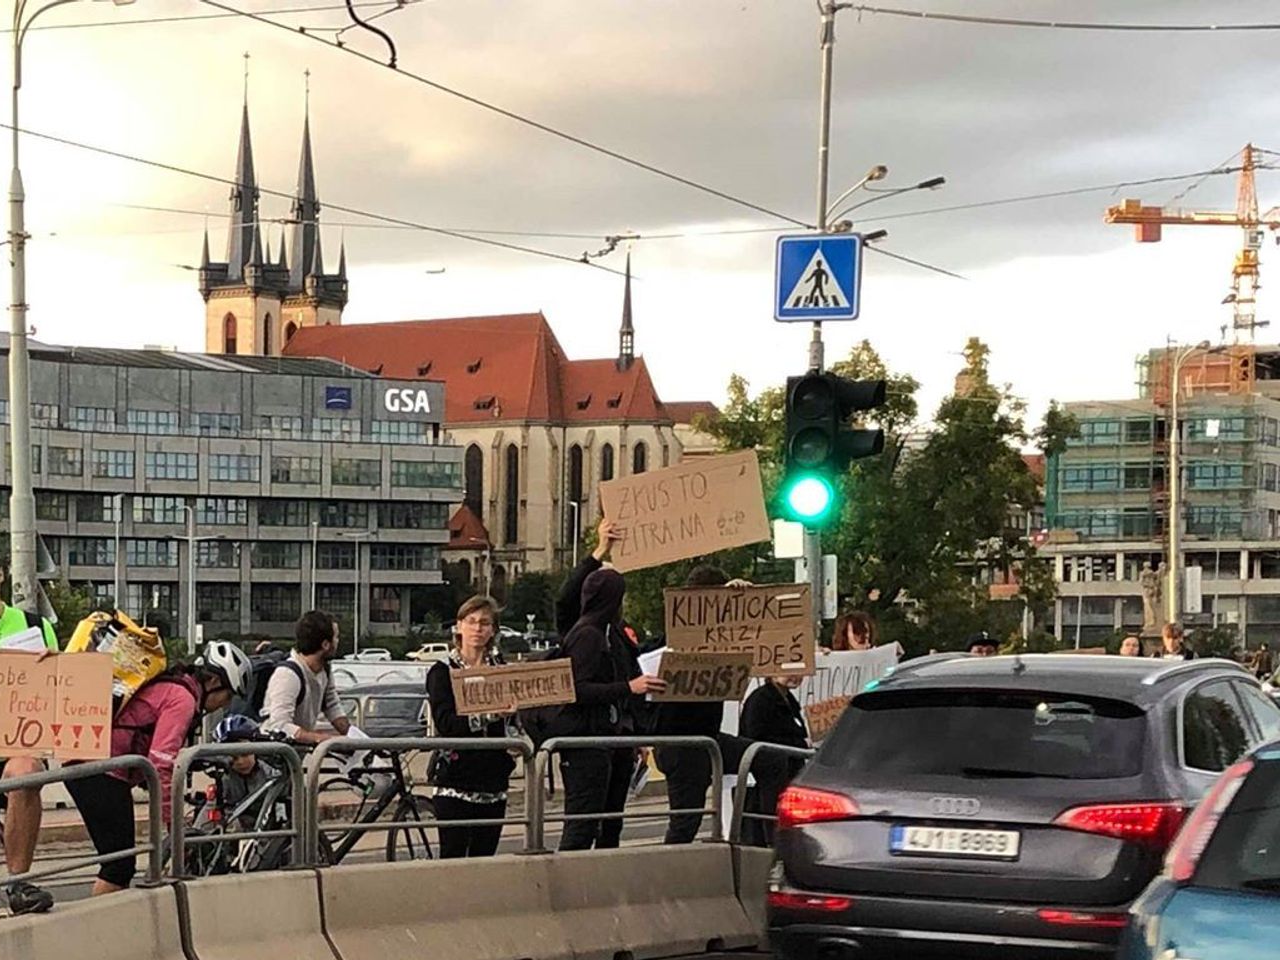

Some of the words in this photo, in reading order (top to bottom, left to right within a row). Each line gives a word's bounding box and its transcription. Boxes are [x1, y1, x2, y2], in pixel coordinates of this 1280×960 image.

[384, 388, 431, 413] GSA
[617, 480, 670, 520] ZKUS
[677, 471, 708, 502] TO
[680, 511, 705, 541] NA
[46, 672, 75, 687] nic
[9, 690, 49, 713] Proti
